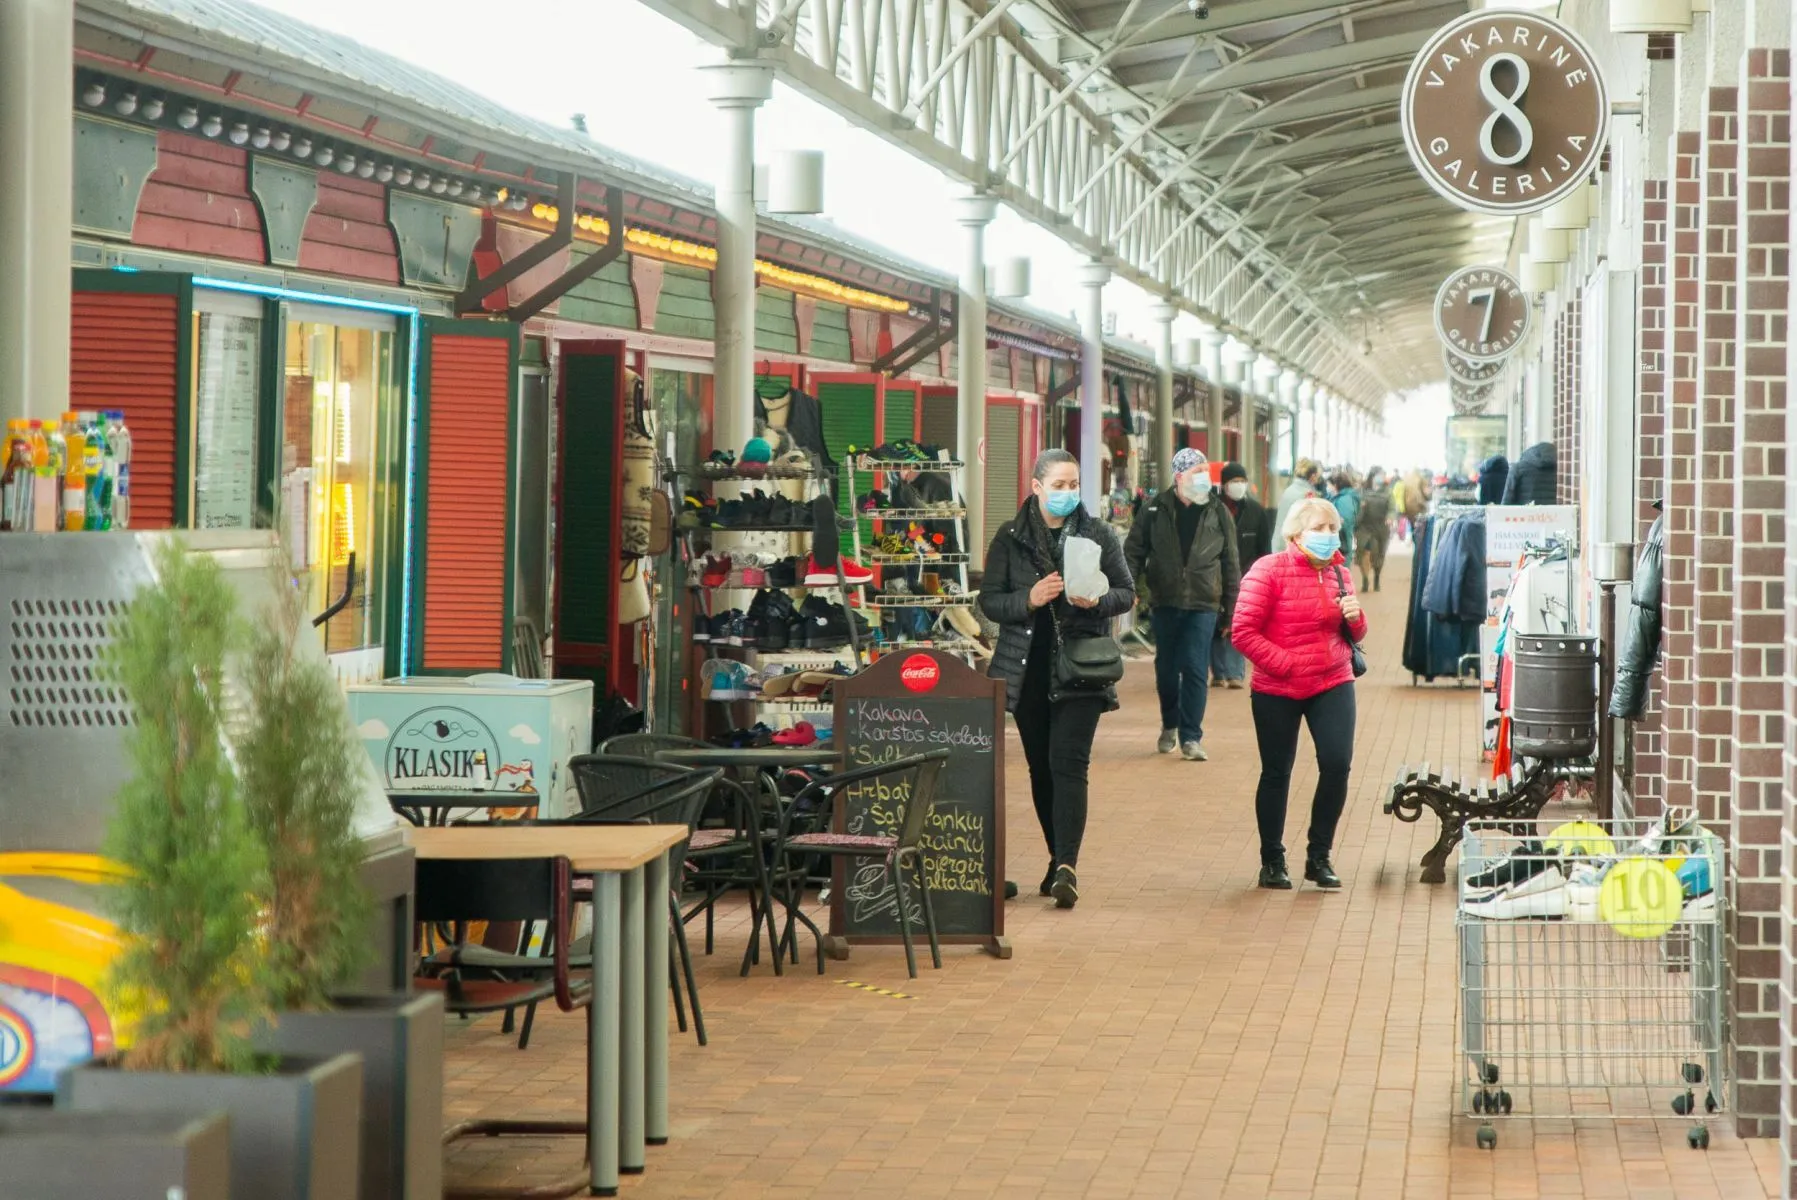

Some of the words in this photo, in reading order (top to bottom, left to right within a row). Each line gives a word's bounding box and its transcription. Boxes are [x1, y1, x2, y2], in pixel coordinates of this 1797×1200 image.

[1425, 26, 1587, 89] VAKARINĖ
[1479, 52, 1533, 165] 8
[1430, 134, 1587, 195] GALERIJA
[1449, 318, 1523, 354] GALERIJA
[1468, 286, 1496, 343] 7
[858, 701, 929, 725] Kakava
[394, 746, 492, 780] KLASIKA
[1612, 869, 1664, 912] 10
